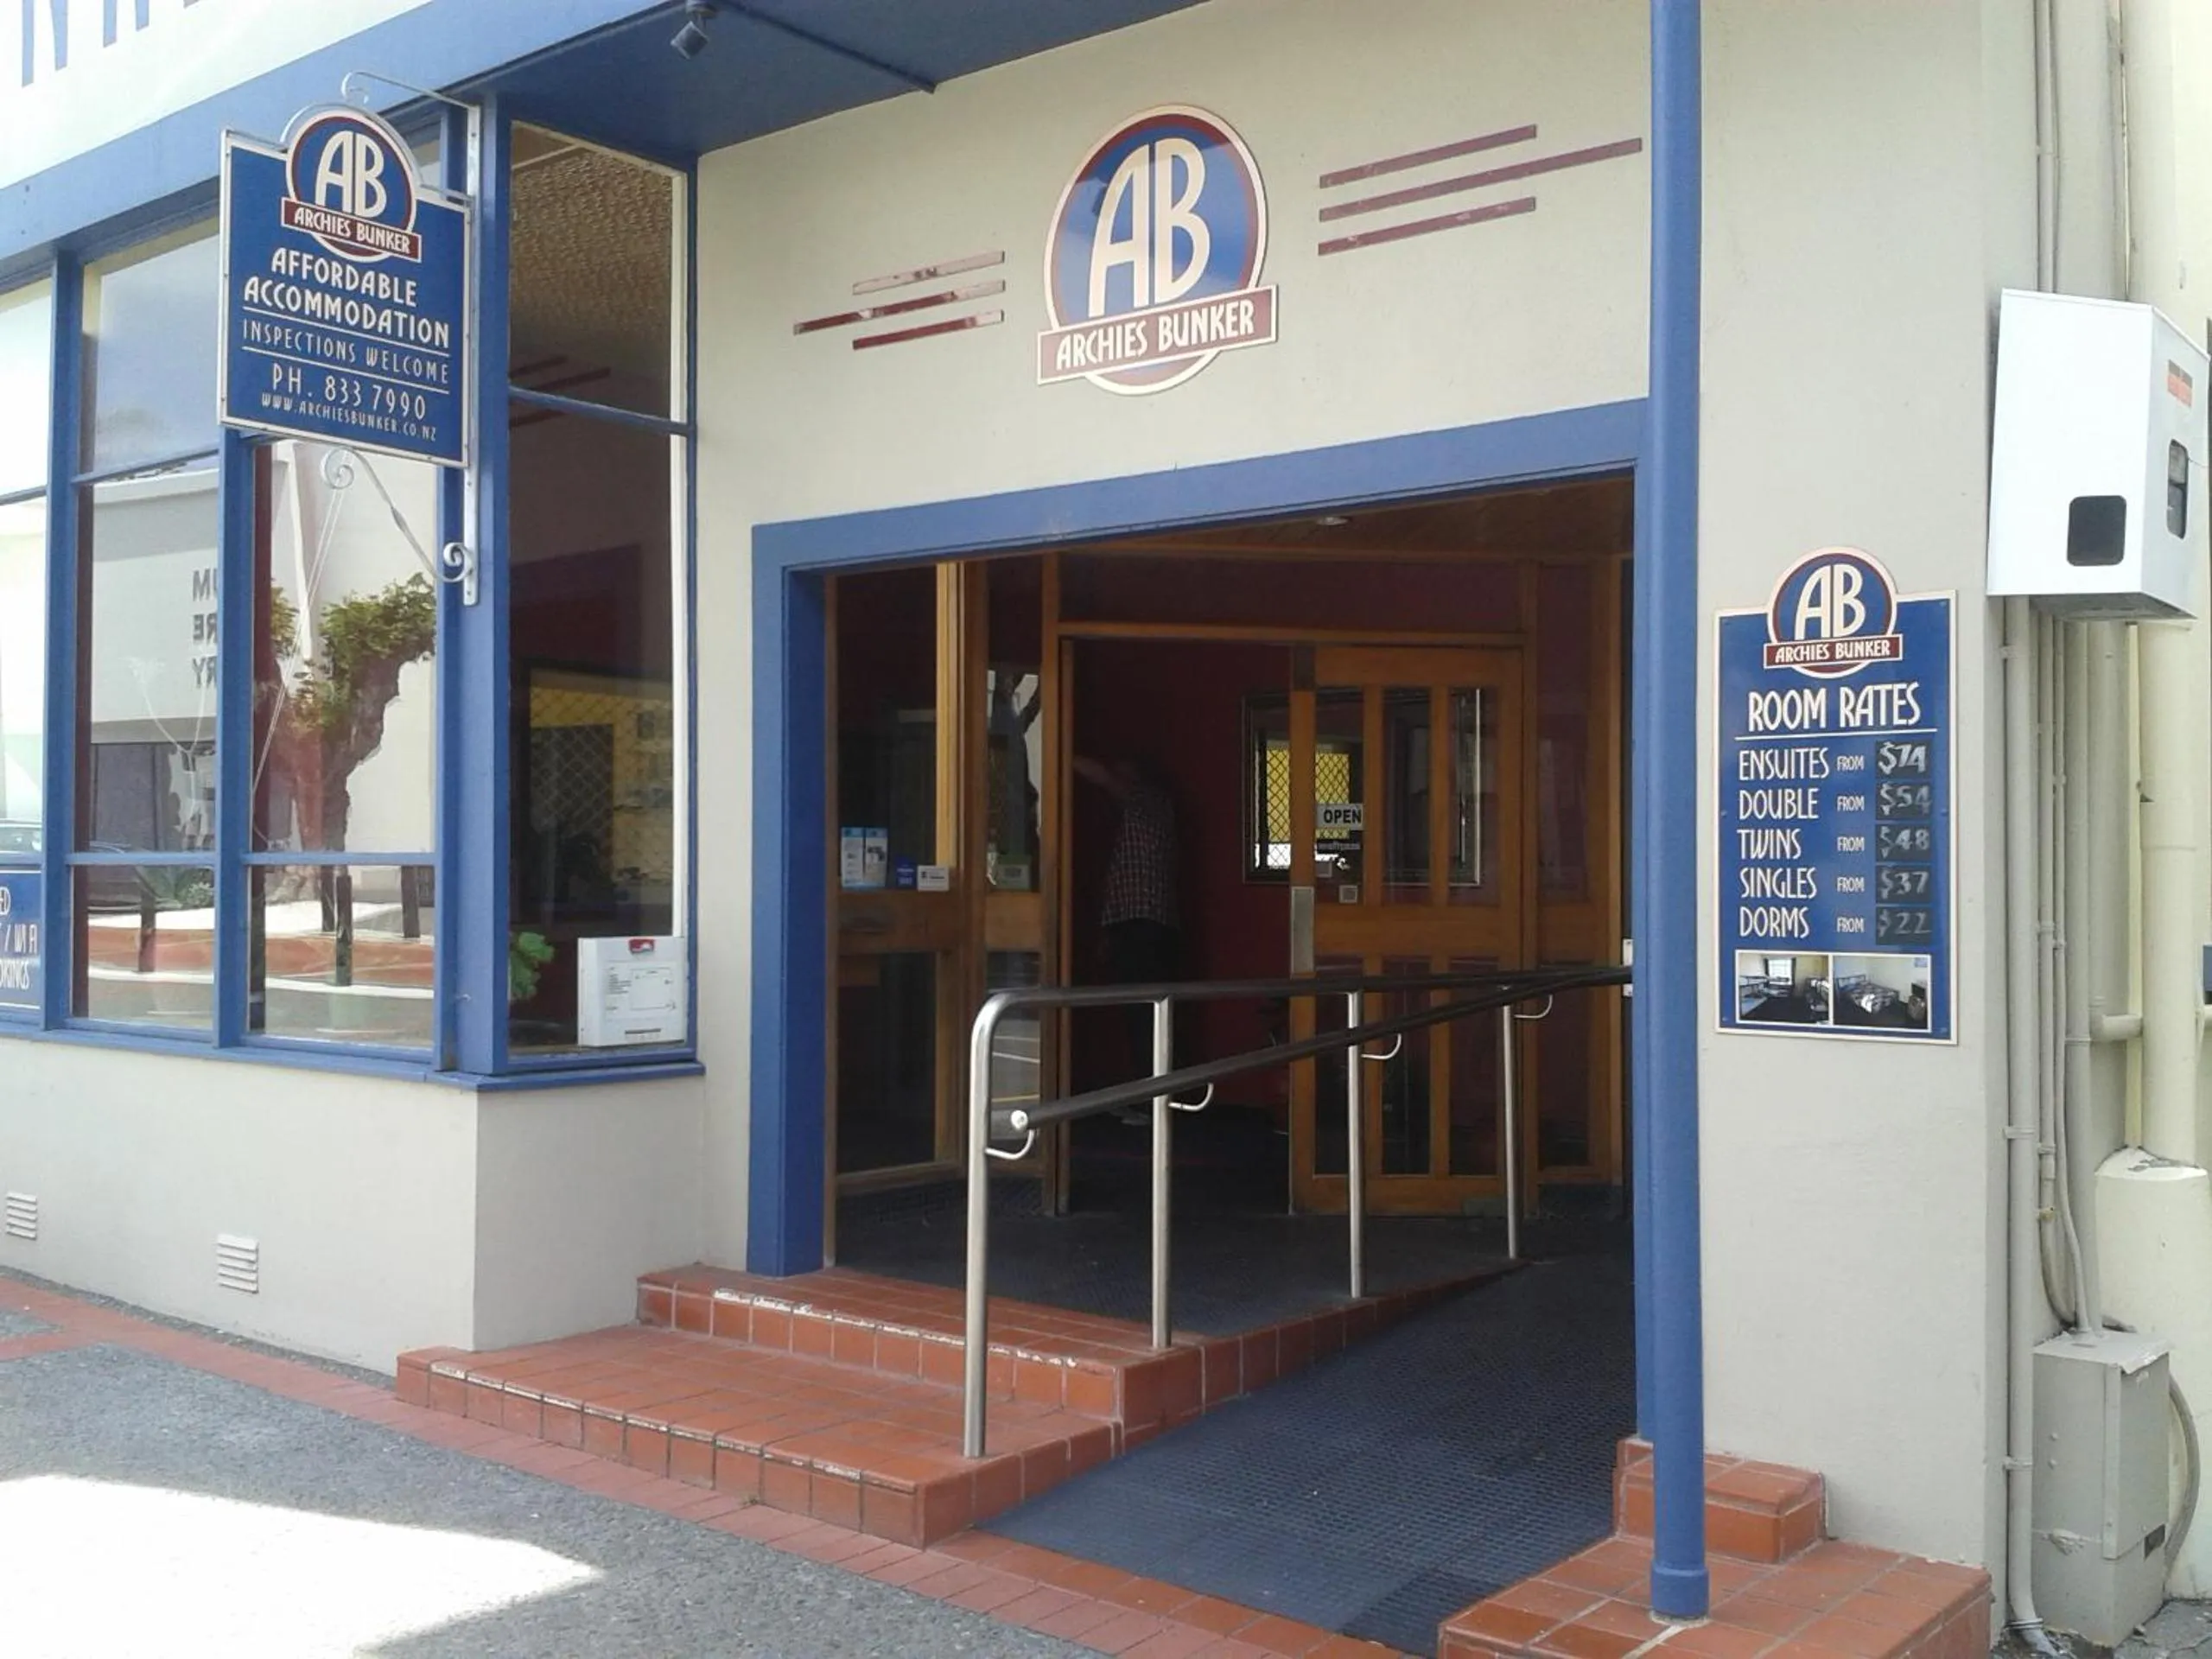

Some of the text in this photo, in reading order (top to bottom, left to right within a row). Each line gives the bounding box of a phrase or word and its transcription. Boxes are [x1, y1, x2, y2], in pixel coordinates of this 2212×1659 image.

[315, 130, 387, 219] AB
[294, 207, 410, 254] ARCHIES BUNKER
[1088, 137, 1211, 318] AB
[271, 247, 417, 308] AFFORDABLE
[244, 276, 449, 348] ACCOMMODATION
[1056, 299, 1255, 371] ARCHIES BUNKER
[243, 319, 449, 385] INSPECTIONS WELCOME
[272, 363, 426, 420] PH. 833 7990
[1795, 563, 1866, 640] AB
[1775, 639, 1891, 664] ARCHIES BUNKER
[1748, 682, 1921, 733] ROOM RATES
[1738, 747, 1829, 781] ENSUITES
[1836, 755, 1865, 772] FROM
[1324, 810, 1362, 823] OPEN
[1739, 783, 1932, 820] DOUBLE FROM $54
[1737, 826, 1929, 860] TWINS FROM $48
[1739, 867, 1929, 899] SINGLES FROM $37
[1739, 906, 1932, 938] DORMS FROM $22
